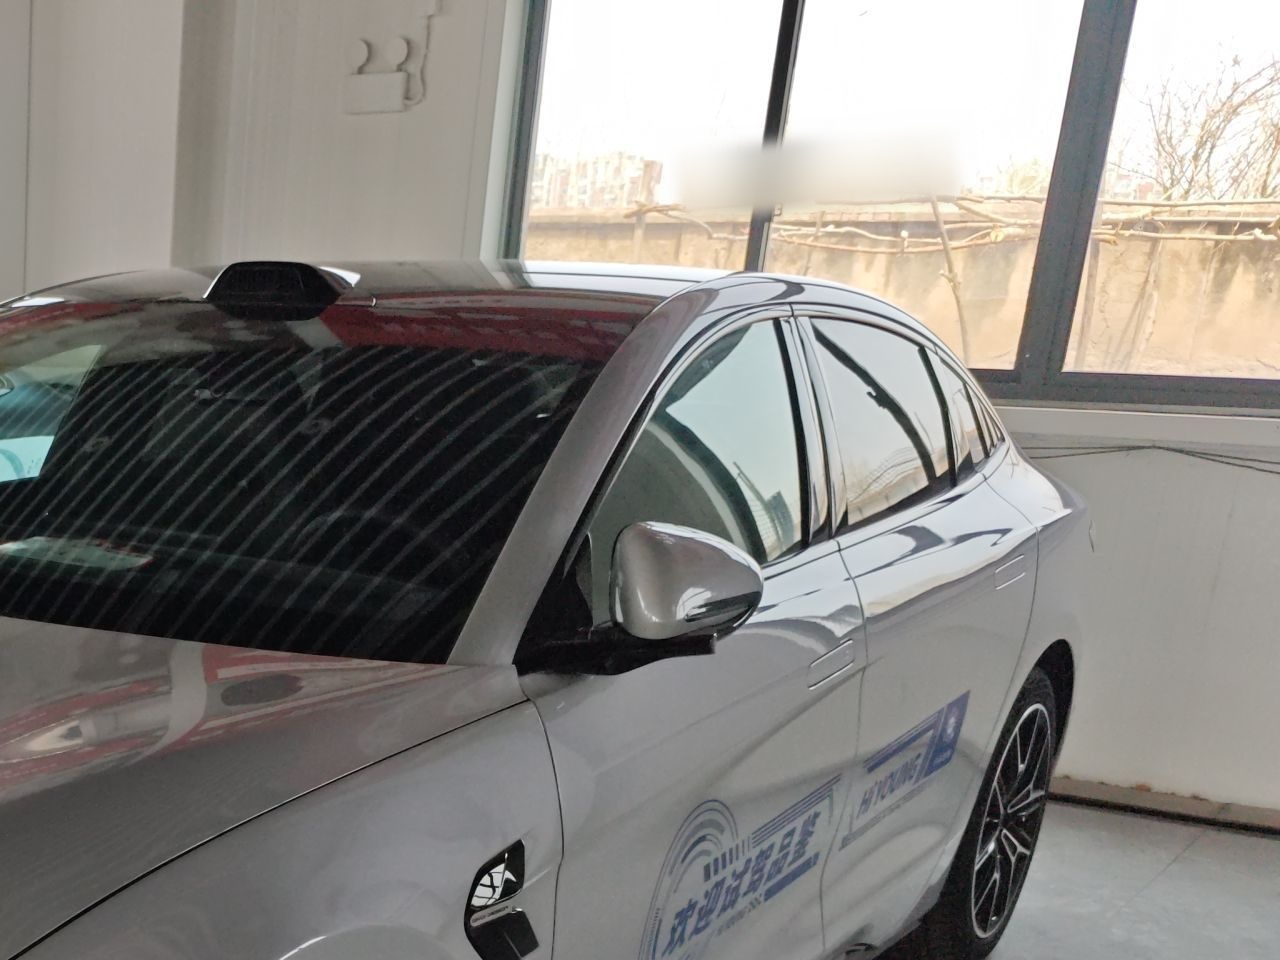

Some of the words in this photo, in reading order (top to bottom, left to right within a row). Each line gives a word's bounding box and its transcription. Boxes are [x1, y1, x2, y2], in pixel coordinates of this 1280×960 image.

[661, 811, 821, 958] 欢迎试驾品鉴
